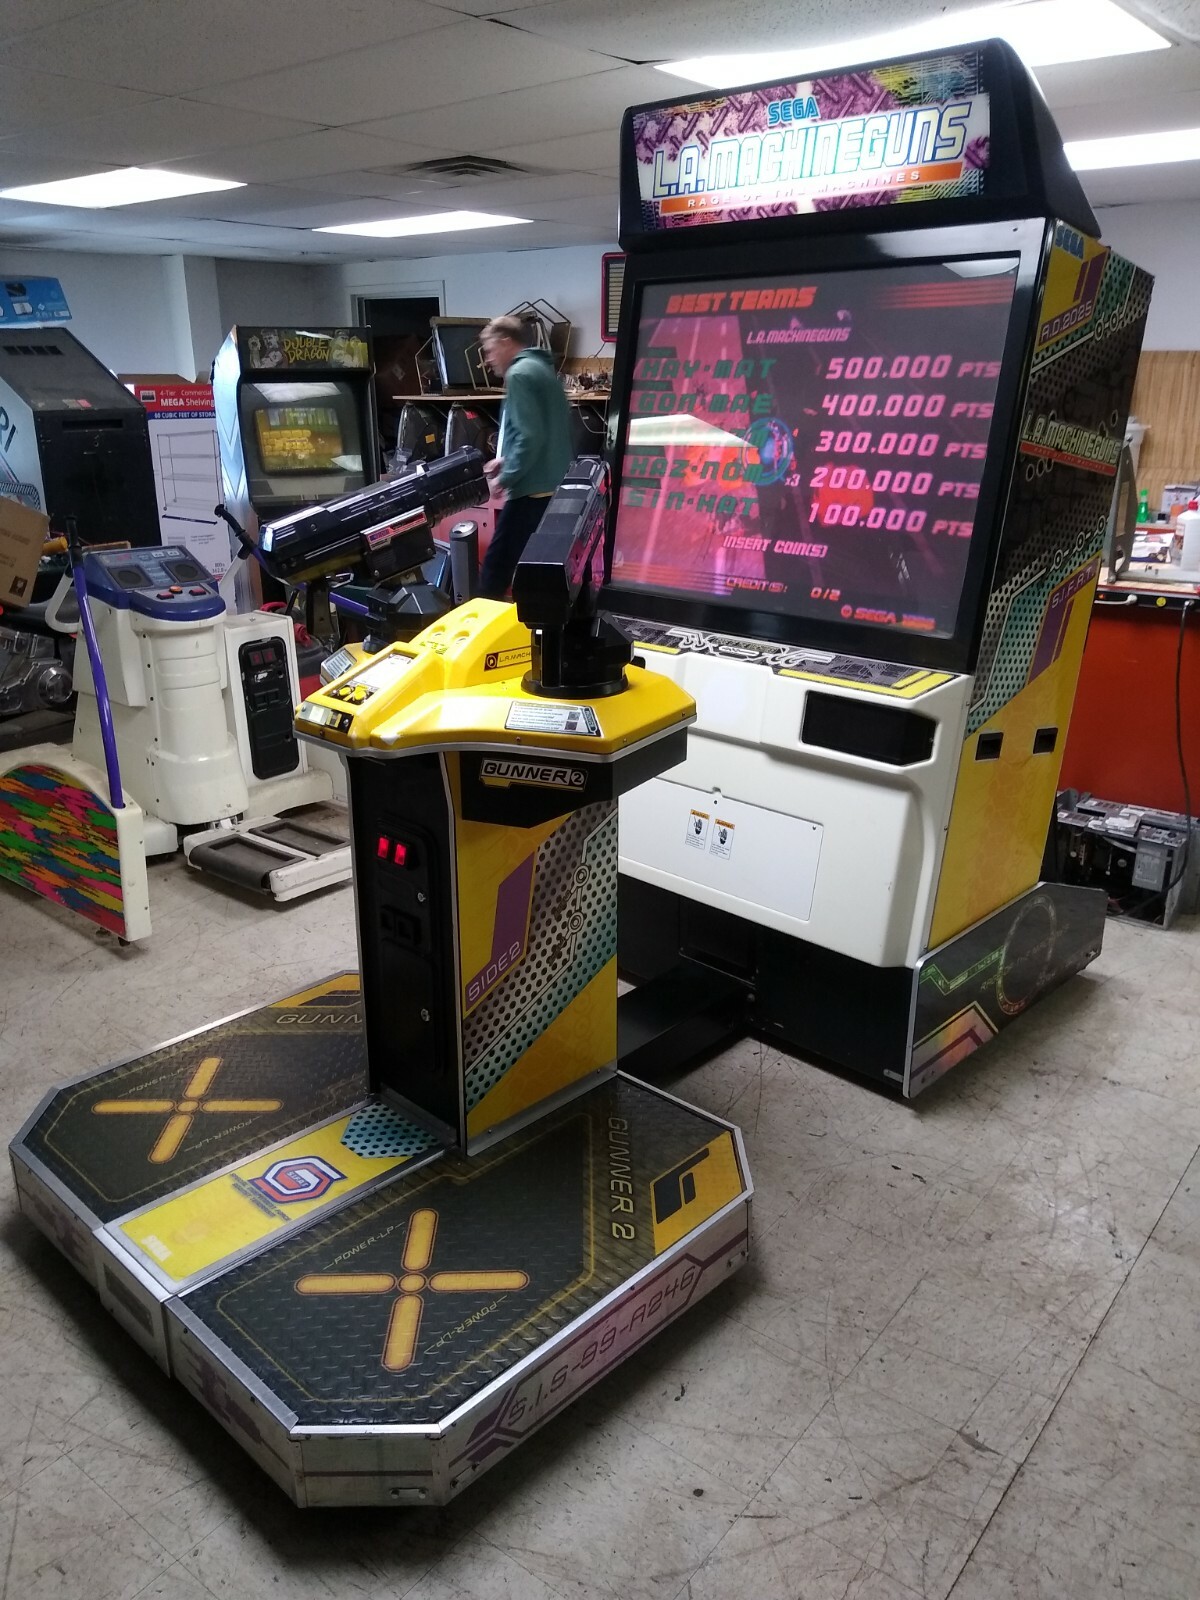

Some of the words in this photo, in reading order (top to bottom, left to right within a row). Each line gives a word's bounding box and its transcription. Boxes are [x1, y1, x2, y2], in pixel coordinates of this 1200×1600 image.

[768, 96, 819, 126] SEGA
[687, 192, 732, 208] RAGE
[1055, 226, 1085, 260] SEGA
[665, 289, 726, 315] BEST
[730, 286, 818, 313] TEAMS
[283, 336, 328, 350] DOUBLE
[287, 348, 332, 364] DRAGON
[826, 354, 953, 381] 500.000
[957, 361, 1002, 380] PTS
[160, 398, 185, 407] MEGA
[186, 398, 215, 408] Shelving
[821, 394, 947, 418] 400.000
[950, 401, 995, 420] PTS
[814, 430, 941, 458] 300.000
[943, 442, 989, 460] PTS
[809, 466, 934, 496] 200.000
[937, 480, 982, 499] PTS
[808, 502, 928, 533] 100.000
[931, 518, 975, 538] PTS
[723, 535, 773, 552] INSERT
[774, 539, 828, 559] COIN(S)
[854, 607, 897, 625] SEGA
[483, 762, 569, 784] GUNNER
[276, 1013, 363, 1024] GUNN
[608, 1117, 634, 1213] GUNNER
[611, 1222, 635, 1240] 2
